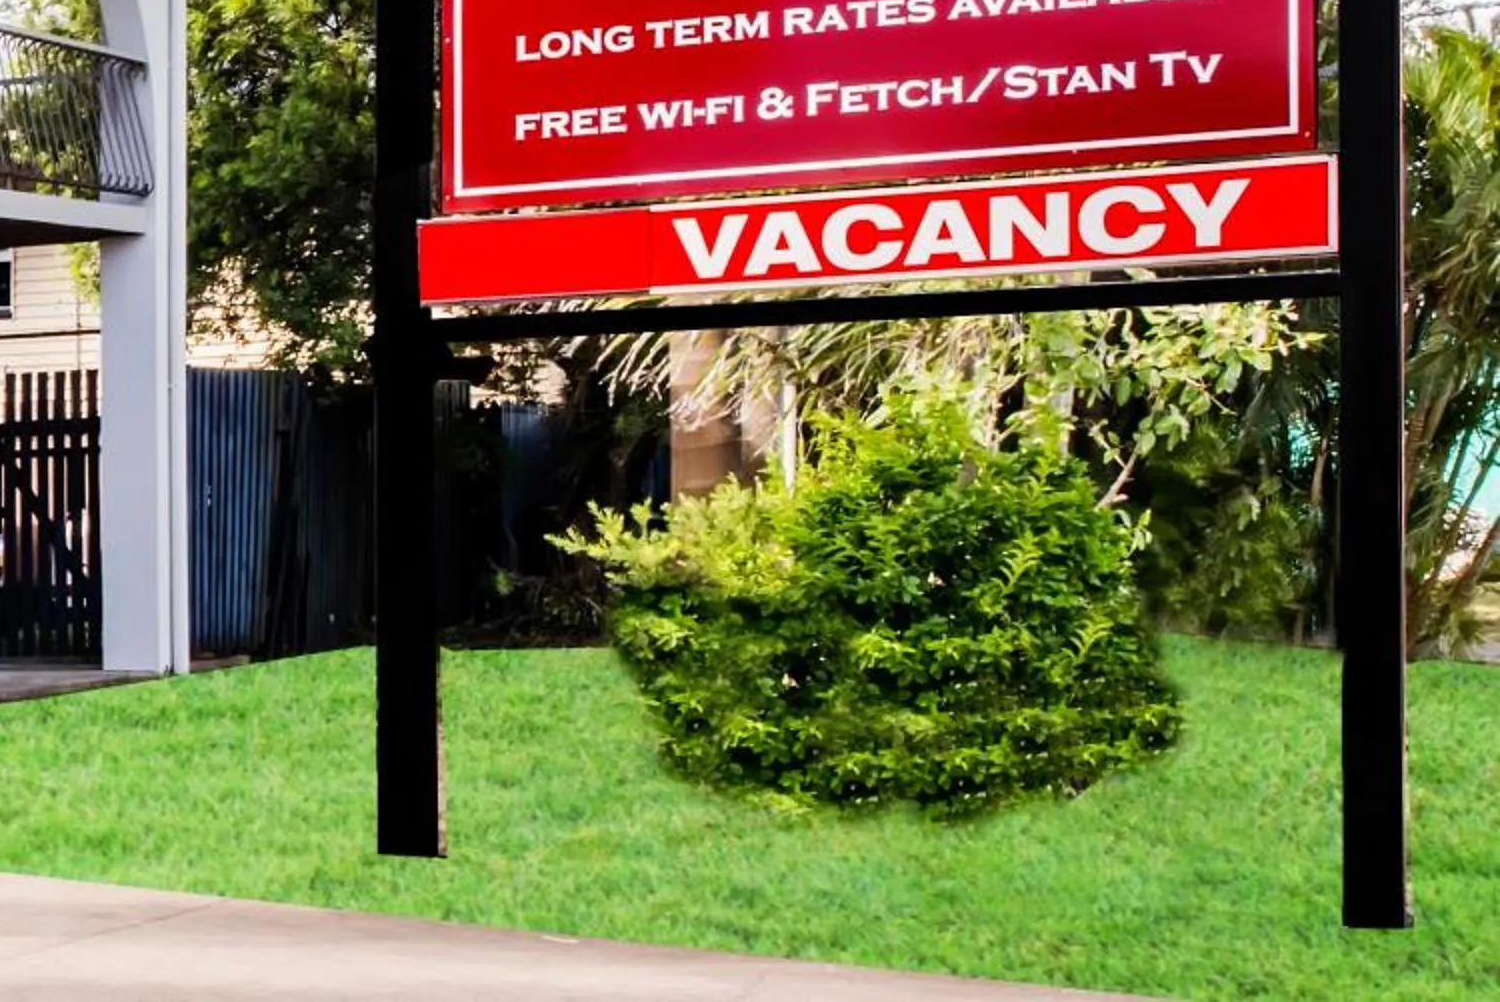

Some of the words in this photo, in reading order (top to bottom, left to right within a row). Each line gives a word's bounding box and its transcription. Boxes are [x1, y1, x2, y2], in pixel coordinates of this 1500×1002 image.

[515, 24, 635, 62] LONG
[646, 11, 769, 50] TERM
[514, 105, 627, 142] FREE
[638, 96, 745, 132] WI-FI
[758, 87, 793, 121] &
[806, 60, 1136, 118] FETCH/STAN
[671, 177, 1252, 280] VACANCY
